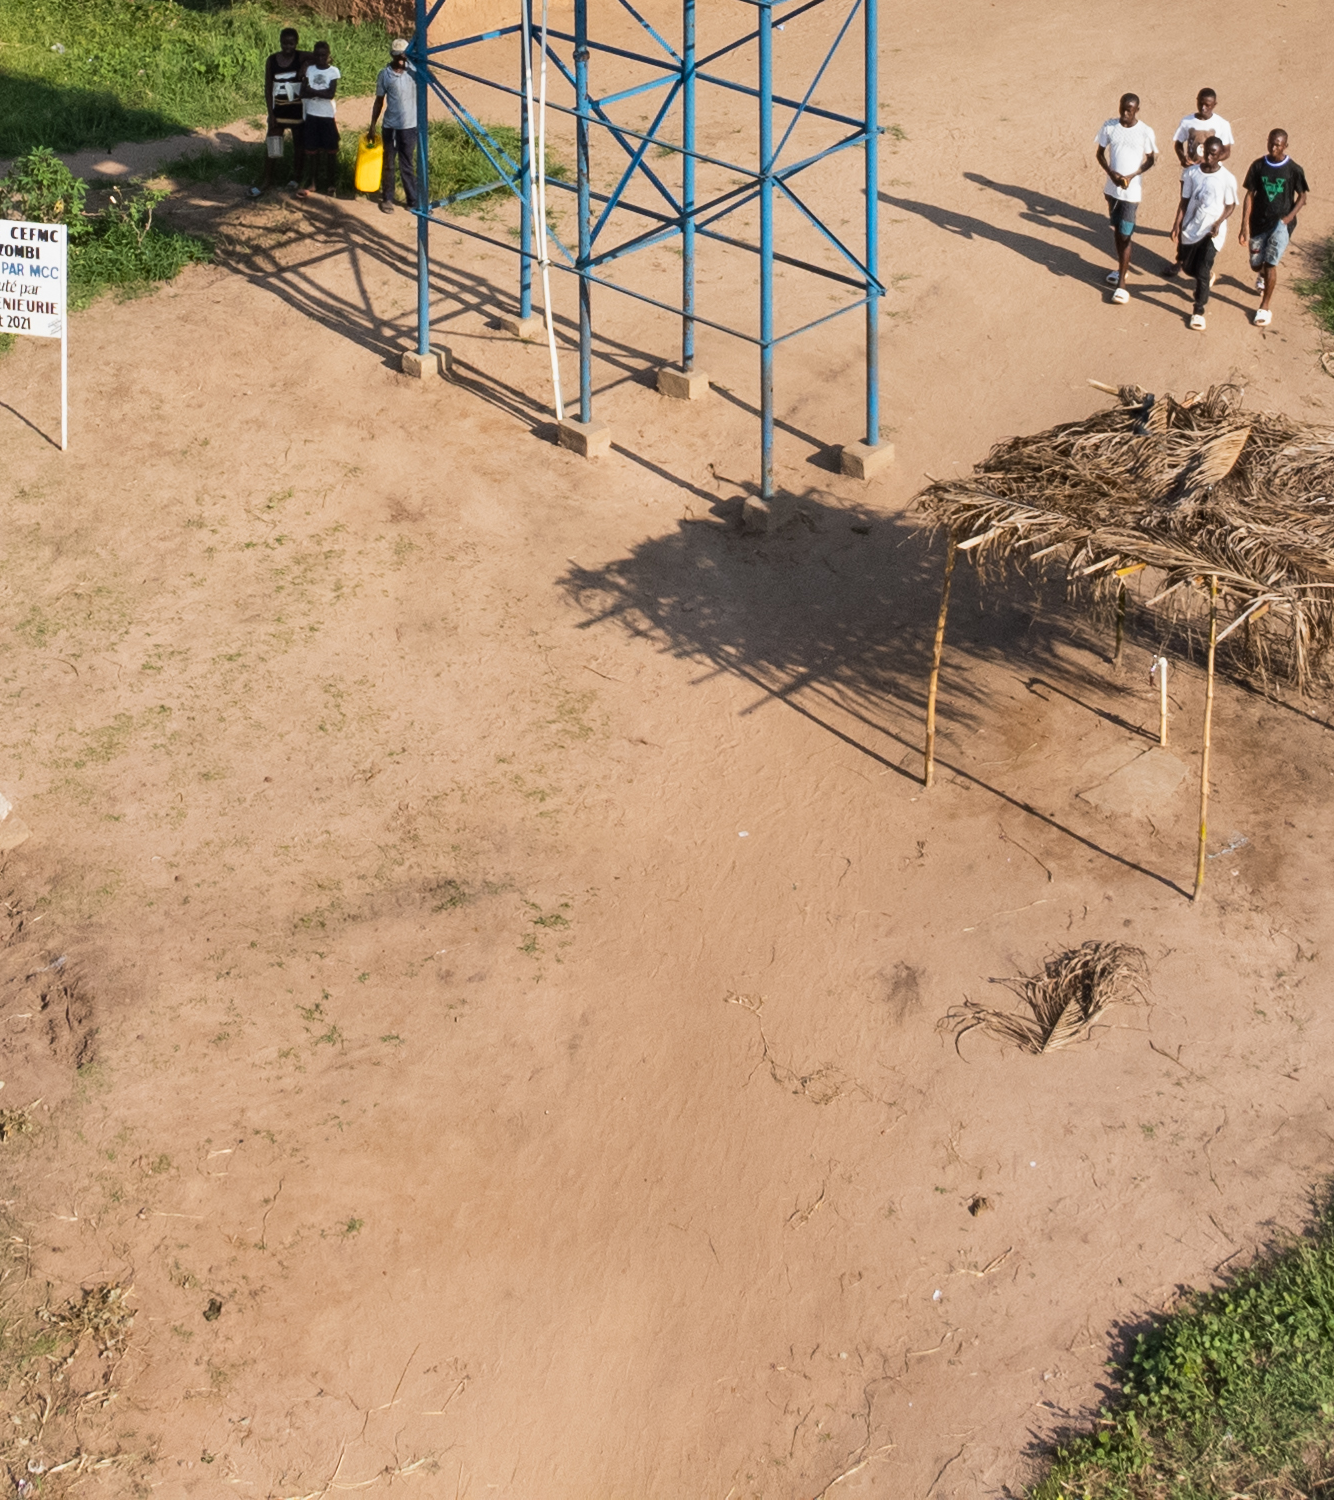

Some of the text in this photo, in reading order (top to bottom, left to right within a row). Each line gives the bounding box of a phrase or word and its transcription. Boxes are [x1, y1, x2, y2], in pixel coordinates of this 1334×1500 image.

[10, 226, 59, 243] CEFMC
[2, 261, 24, 276] PAR
[29, 264, 59, 280] MCC
[20, 284, 42, 297] par
[7, 314, 31, 330] 2021
